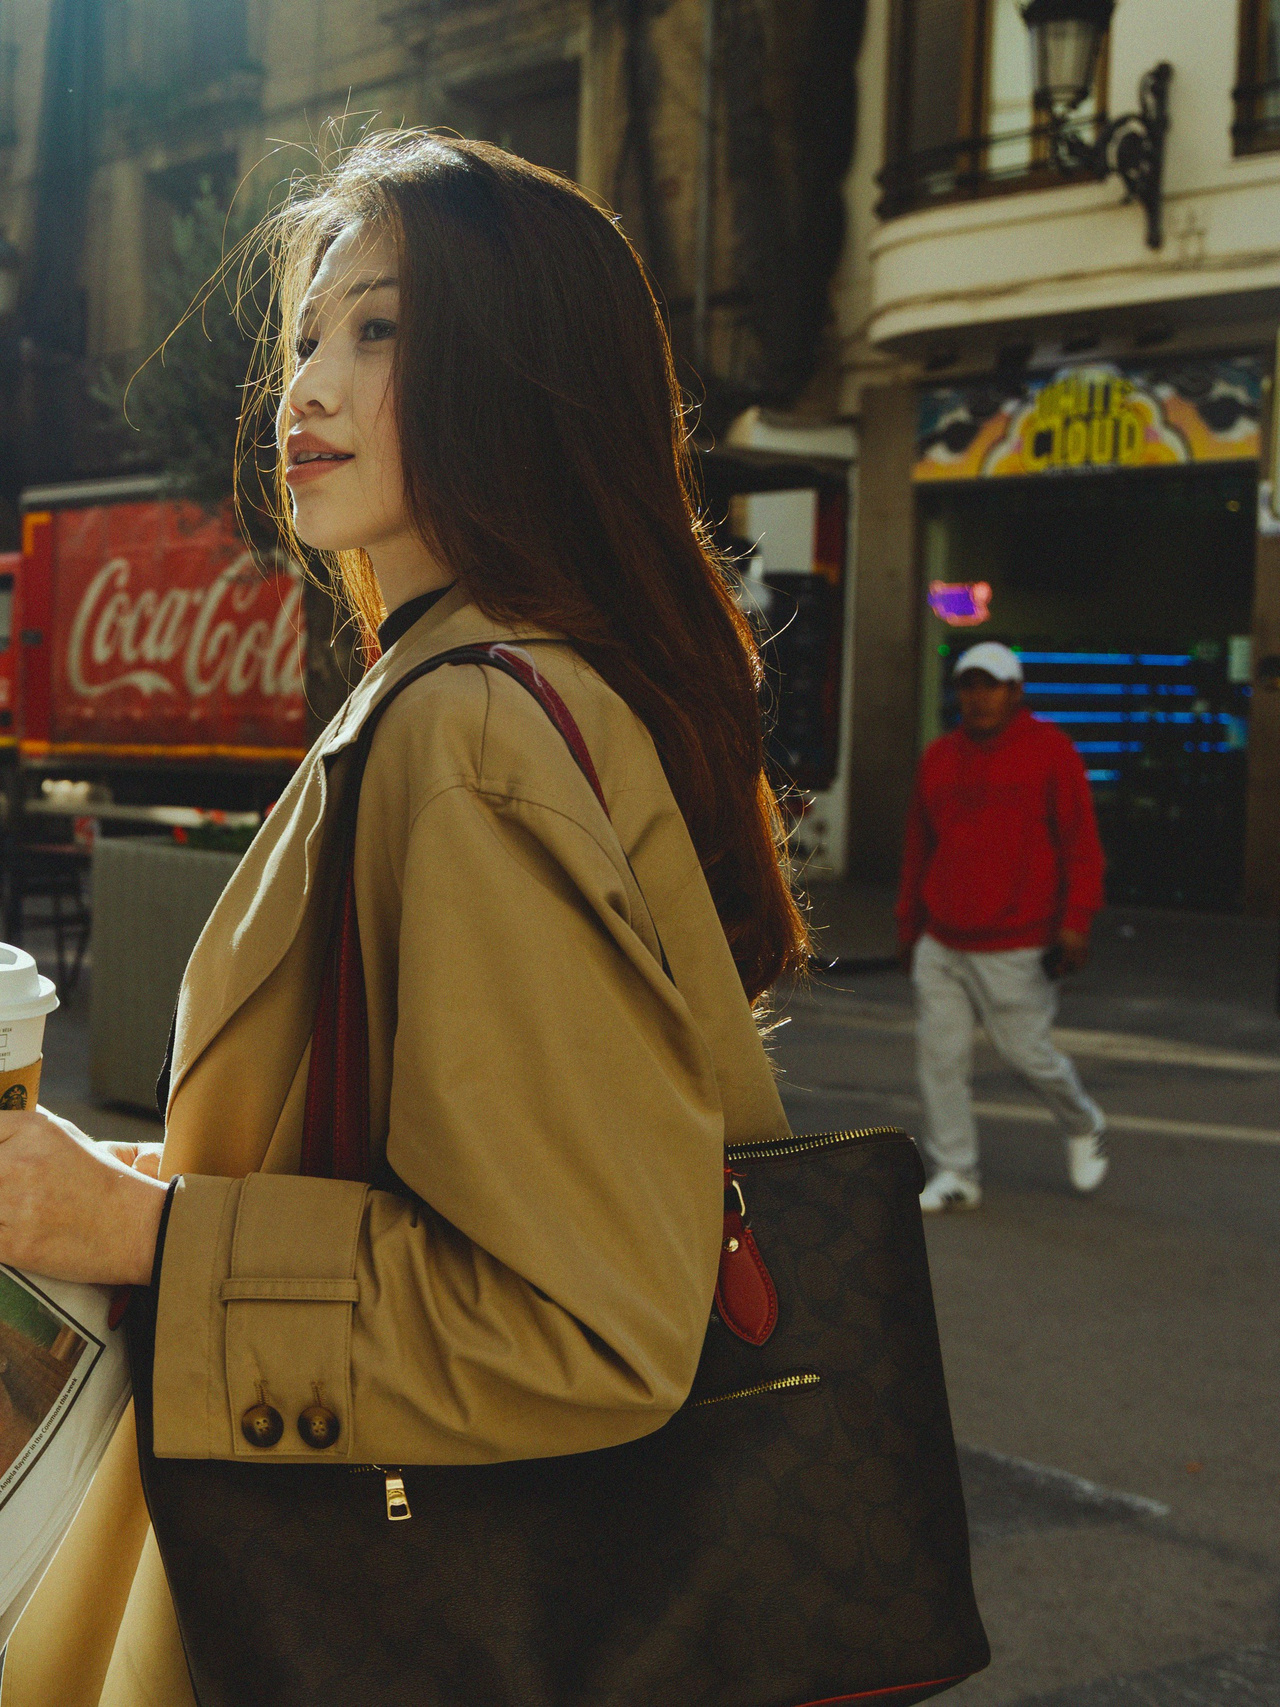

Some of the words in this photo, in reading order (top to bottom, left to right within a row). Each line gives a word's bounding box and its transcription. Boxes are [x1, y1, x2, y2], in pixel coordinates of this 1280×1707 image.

[1023, 412, 1141, 466] CLOUD
[0, 1470, 17, 1490] Angela
[14, 1450, 31, 1470] Rayner
[34, 1433, 43, 1444] the
[42, 1405, 62, 1433] Commons
[60, 1394, 68, 1405] this
[67, 1378, 77, 1393] week
